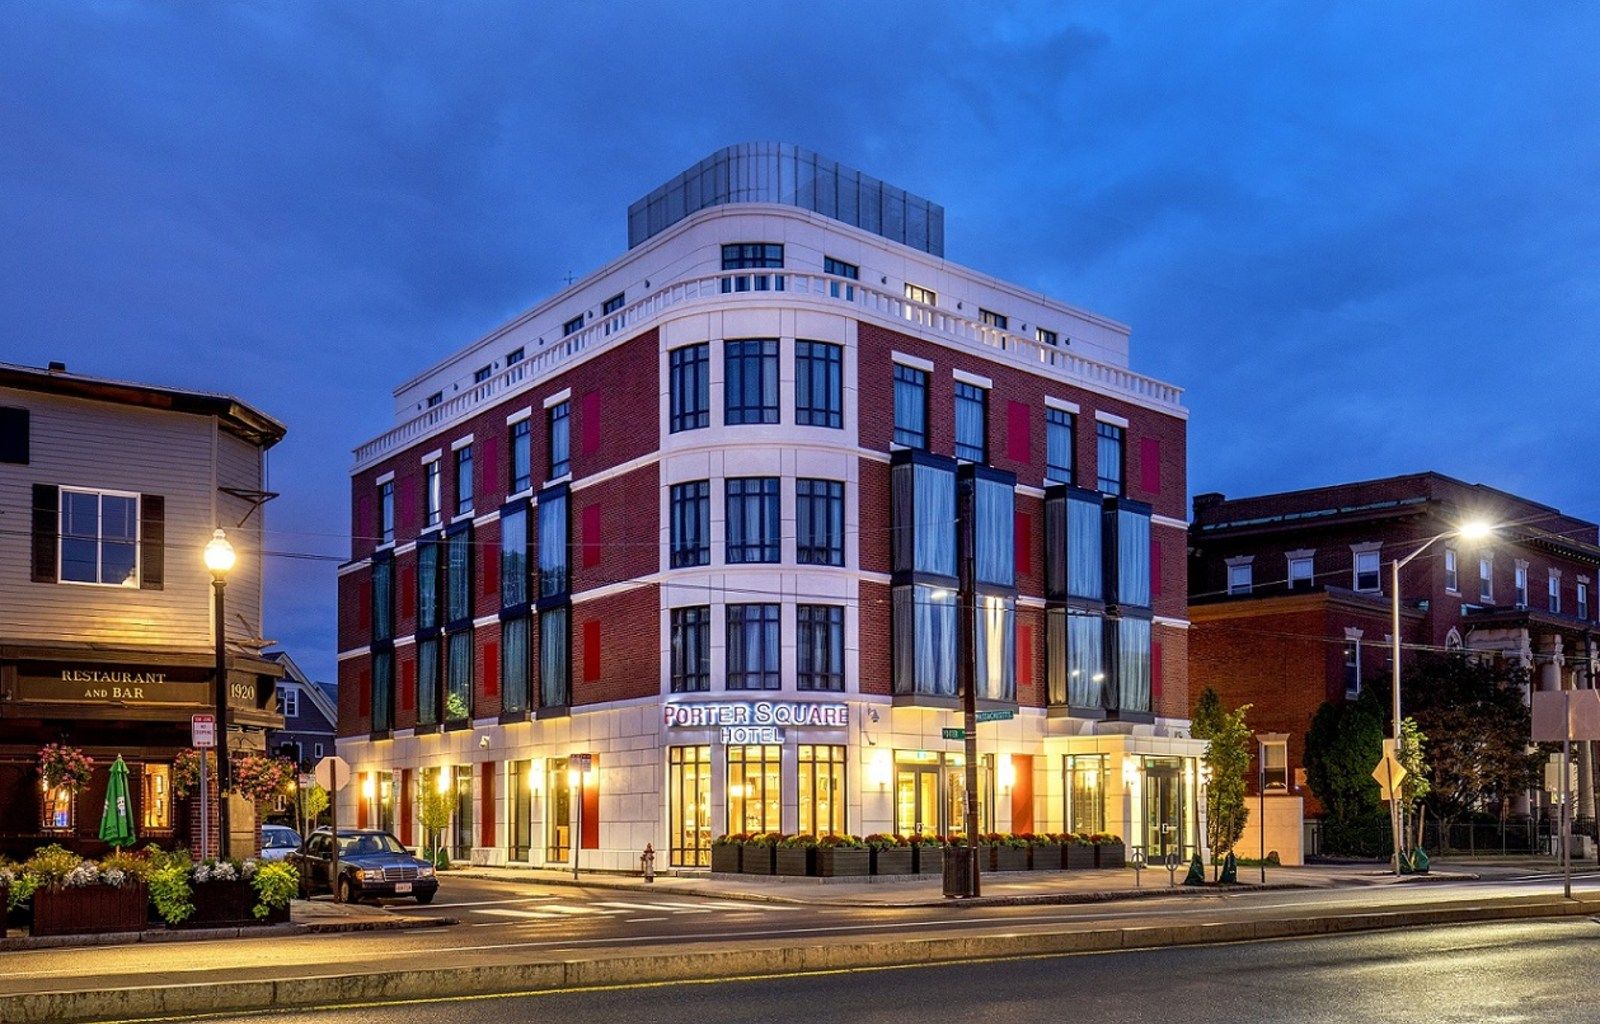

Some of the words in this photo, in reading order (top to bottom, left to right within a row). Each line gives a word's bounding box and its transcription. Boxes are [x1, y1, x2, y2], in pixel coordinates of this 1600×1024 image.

[61, 670, 166, 684] RESTAURANT
[84, 689, 108, 698] AND
[112, 687, 144, 699] BAR
[230, 683, 255, 700] 1920
[664, 704, 747, 726] PORTER
[756, 703, 848, 726] SQUARE
[721, 727, 785, 744] HOTEL
